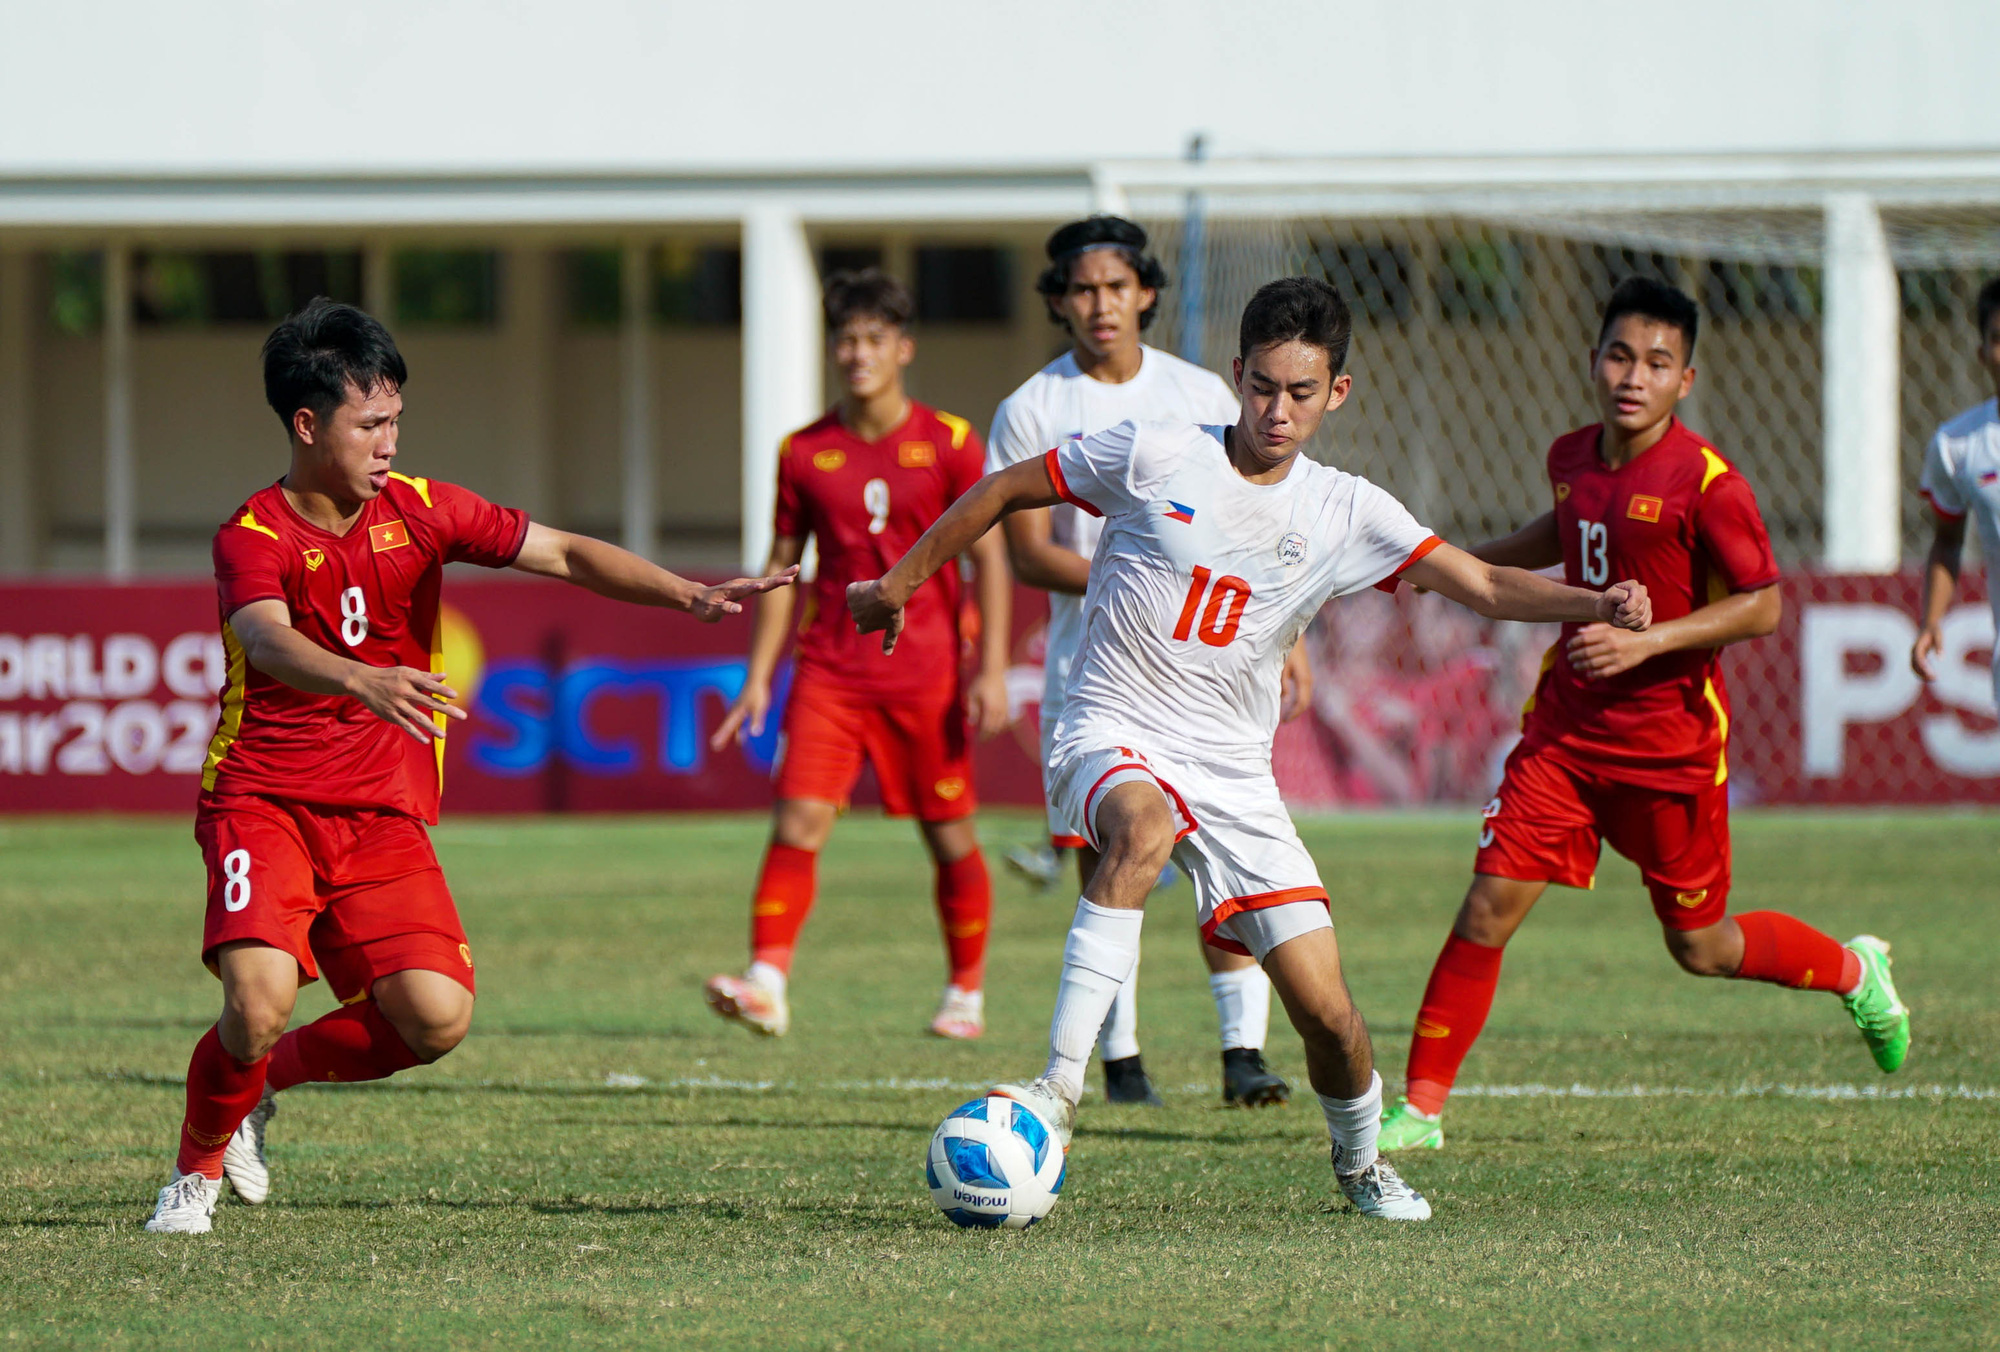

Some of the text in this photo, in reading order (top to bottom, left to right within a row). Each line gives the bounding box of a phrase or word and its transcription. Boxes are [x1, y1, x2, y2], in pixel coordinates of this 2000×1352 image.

[863, 477, 890, 535] 9
[1578, 519, 1609, 586] 13
[340, 586, 369, 647] 8
[1172, 564, 1252, 648] 10
[1802, 603, 2000, 779] PS
[223, 848, 251, 912] 8
[954, 1189, 1007, 1207] molten
